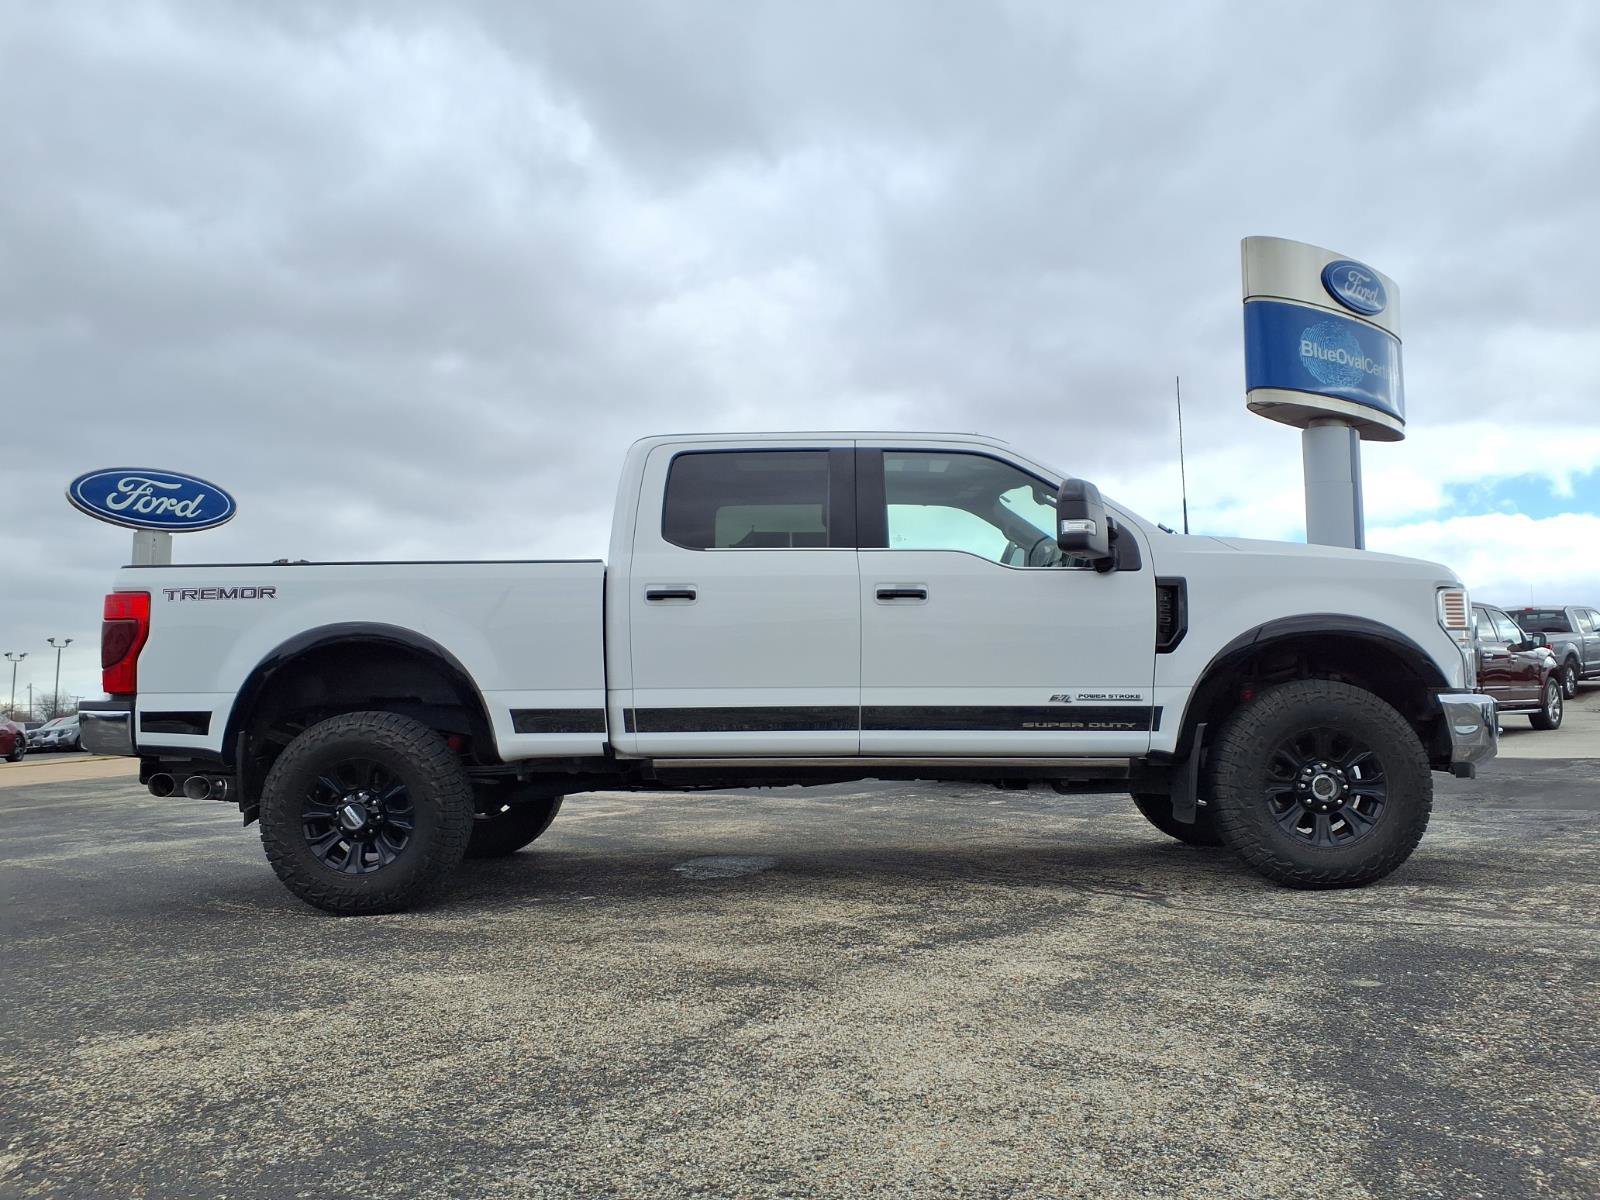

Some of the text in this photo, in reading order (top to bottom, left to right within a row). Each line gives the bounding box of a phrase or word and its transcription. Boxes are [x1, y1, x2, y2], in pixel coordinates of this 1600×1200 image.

[1344, 270, 1380, 302] Ford
[106, 477, 206, 518] Ford
[162, 586, 277, 601] TREMOR
